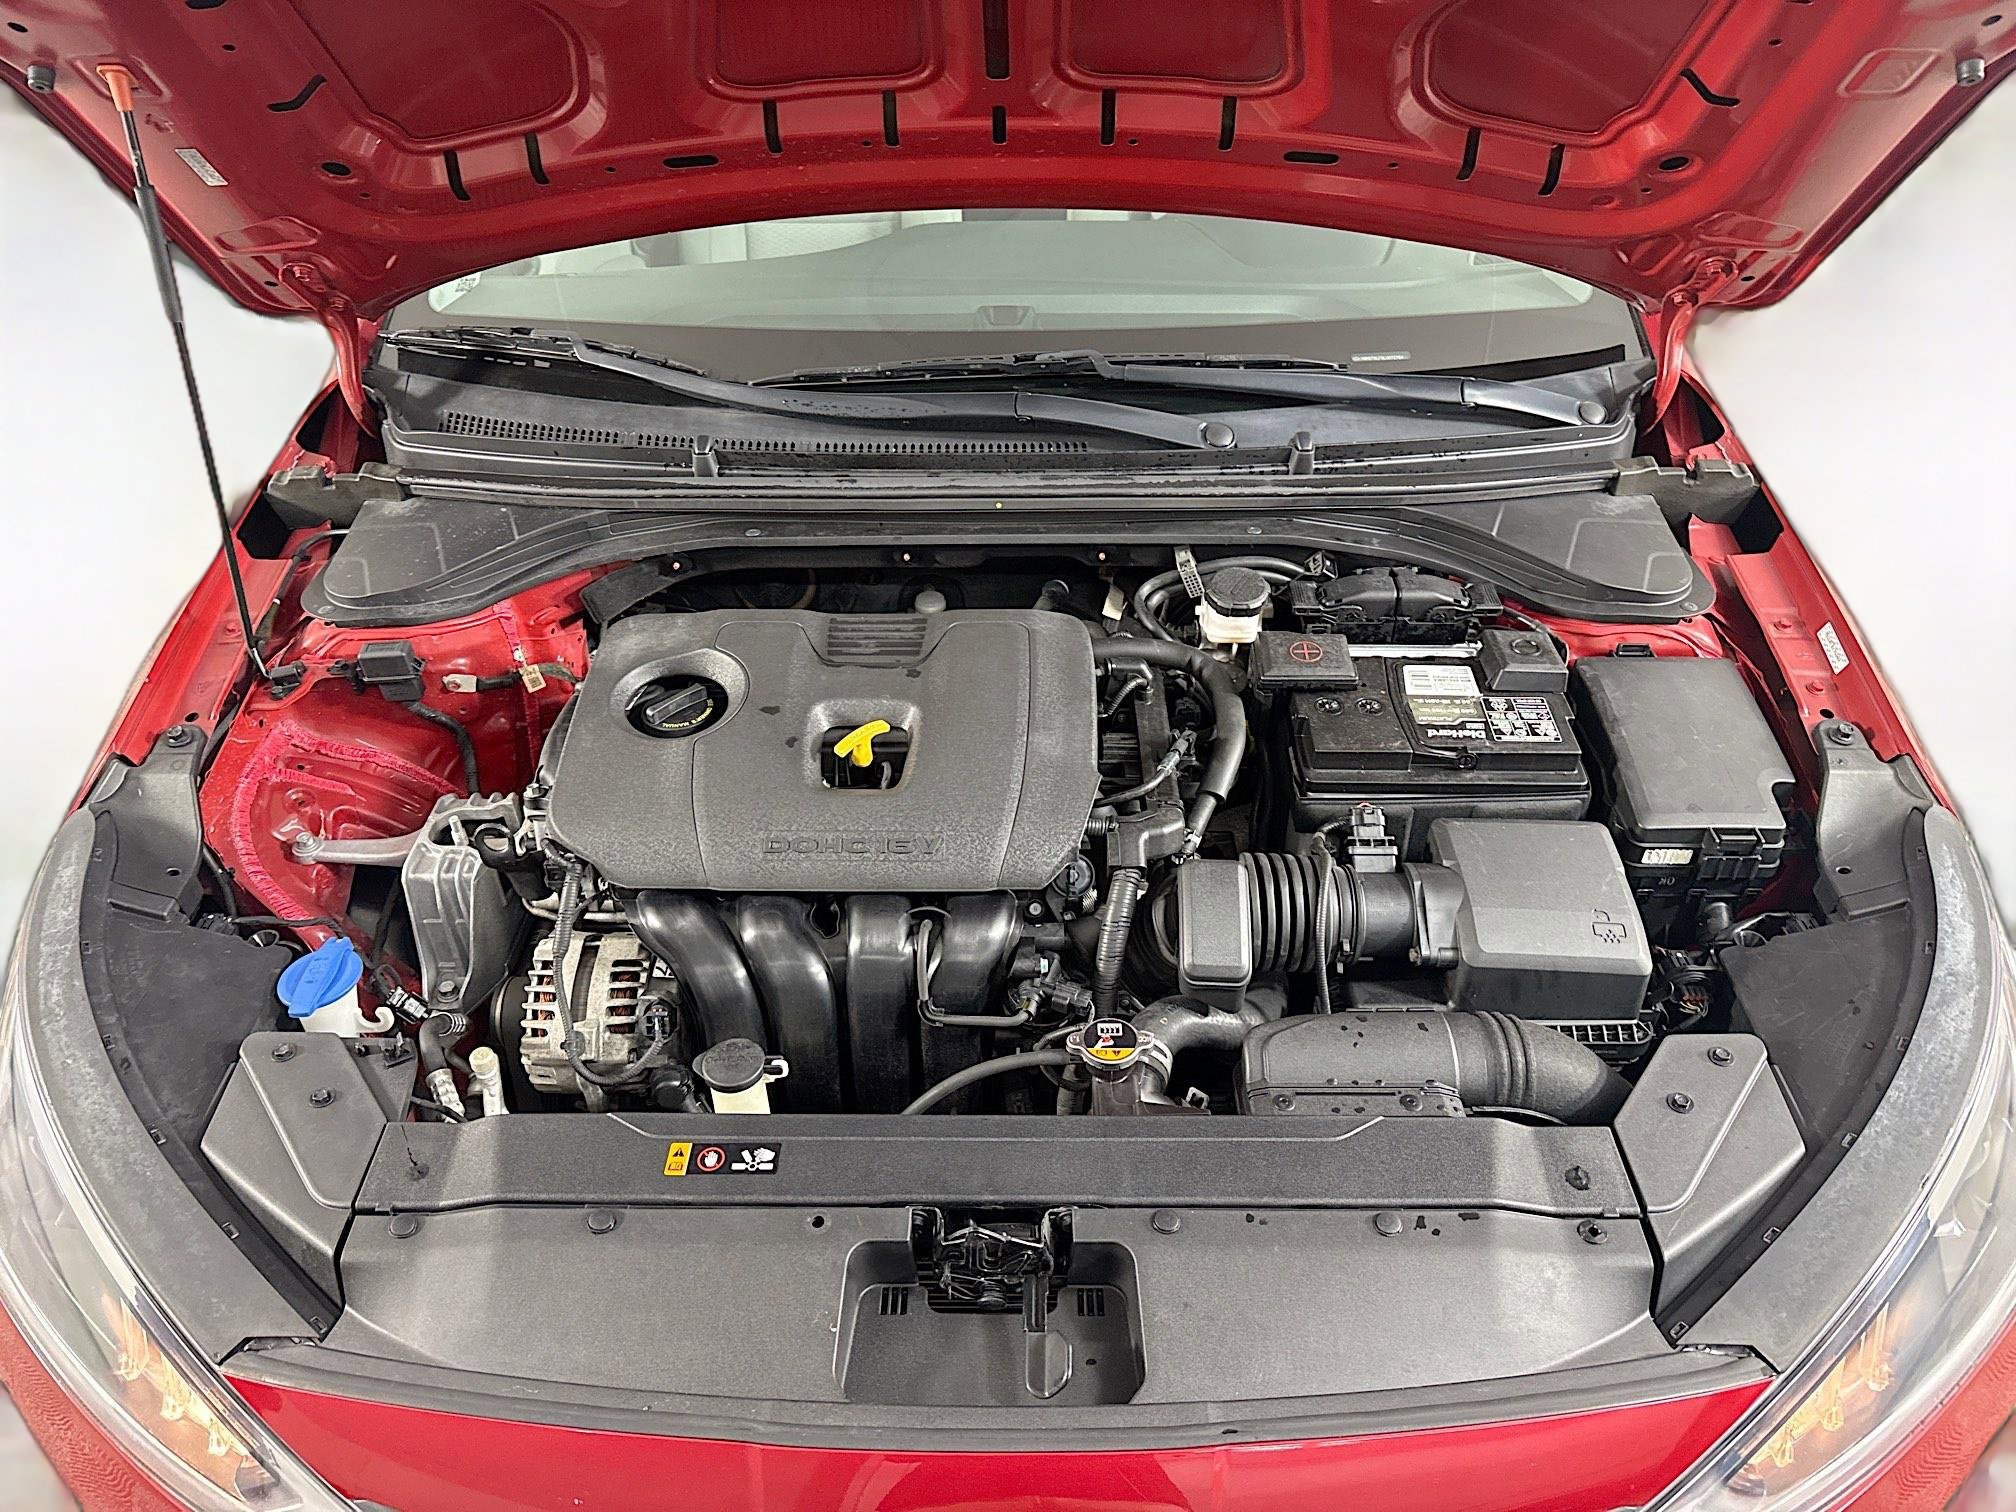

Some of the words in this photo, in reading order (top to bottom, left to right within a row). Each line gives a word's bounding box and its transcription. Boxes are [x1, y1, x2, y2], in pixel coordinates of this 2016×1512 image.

[1427, 729, 1486, 739] DieHard
[762, 836, 871, 854] DOHC
[874, 834, 944, 855] 16V
[1657, 876, 1676, 886] OK
